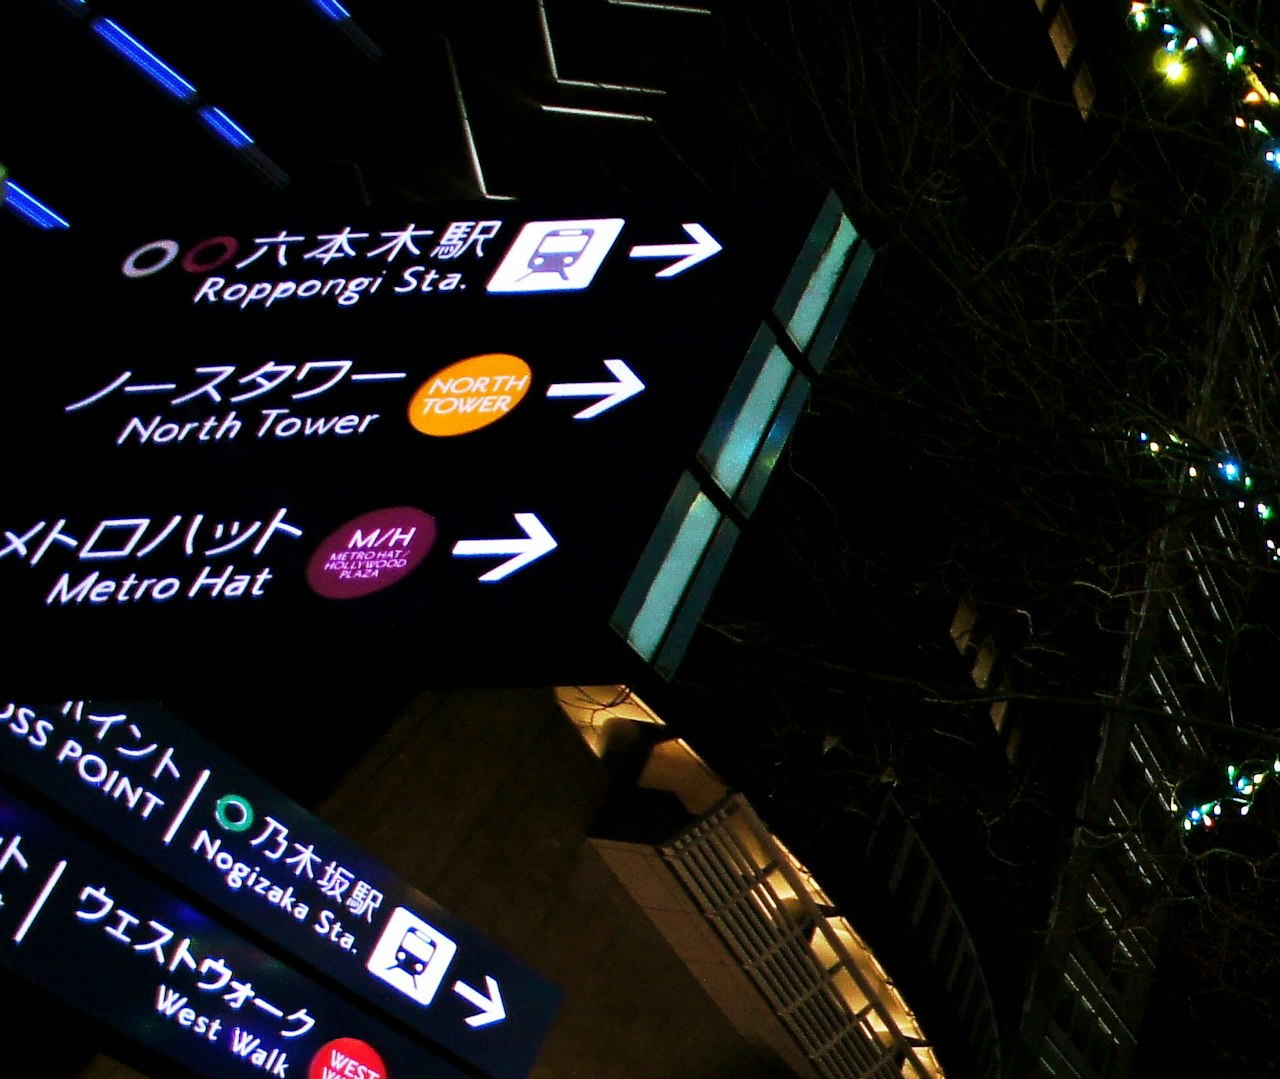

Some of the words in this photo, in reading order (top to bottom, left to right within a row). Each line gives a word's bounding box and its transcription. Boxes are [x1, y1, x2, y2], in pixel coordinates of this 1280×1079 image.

[235, 220, 502, 268] 六本木駅
[193, 270, 387, 309] Roppongi
[394, 266, 466, 293] Sta.
[65, 360, 406, 411] ノースタワー
[423, 395, 512, 415] TOWER
[428, 375, 528, 394] NORTH
[117, 410, 242, 444] North
[257, 409, 380, 438] Tower
[0, 508, 302, 566] メトロハット
[330, 551, 376, 561] METRO
[348, 527, 416, 548] M/H
[47, 571, 180, 605] Metro
[188, 565, 272, 598] Hat
[324, 559, 407, 570] HOLLYWOOD
[339, 569, 379, 579] PLAZA
[56, 739, 164, 818] POINT
[250, 816, 384, 923] 乃木坂駅
[192, 829, 309, 920] Nogizaka
[313, 910, 358, 954] Sta.
[76, 885, 316, 1037] ウェストウォーク
[154, 984, 222, 1041] West
[231, 1027, 290, 1079] Walk
